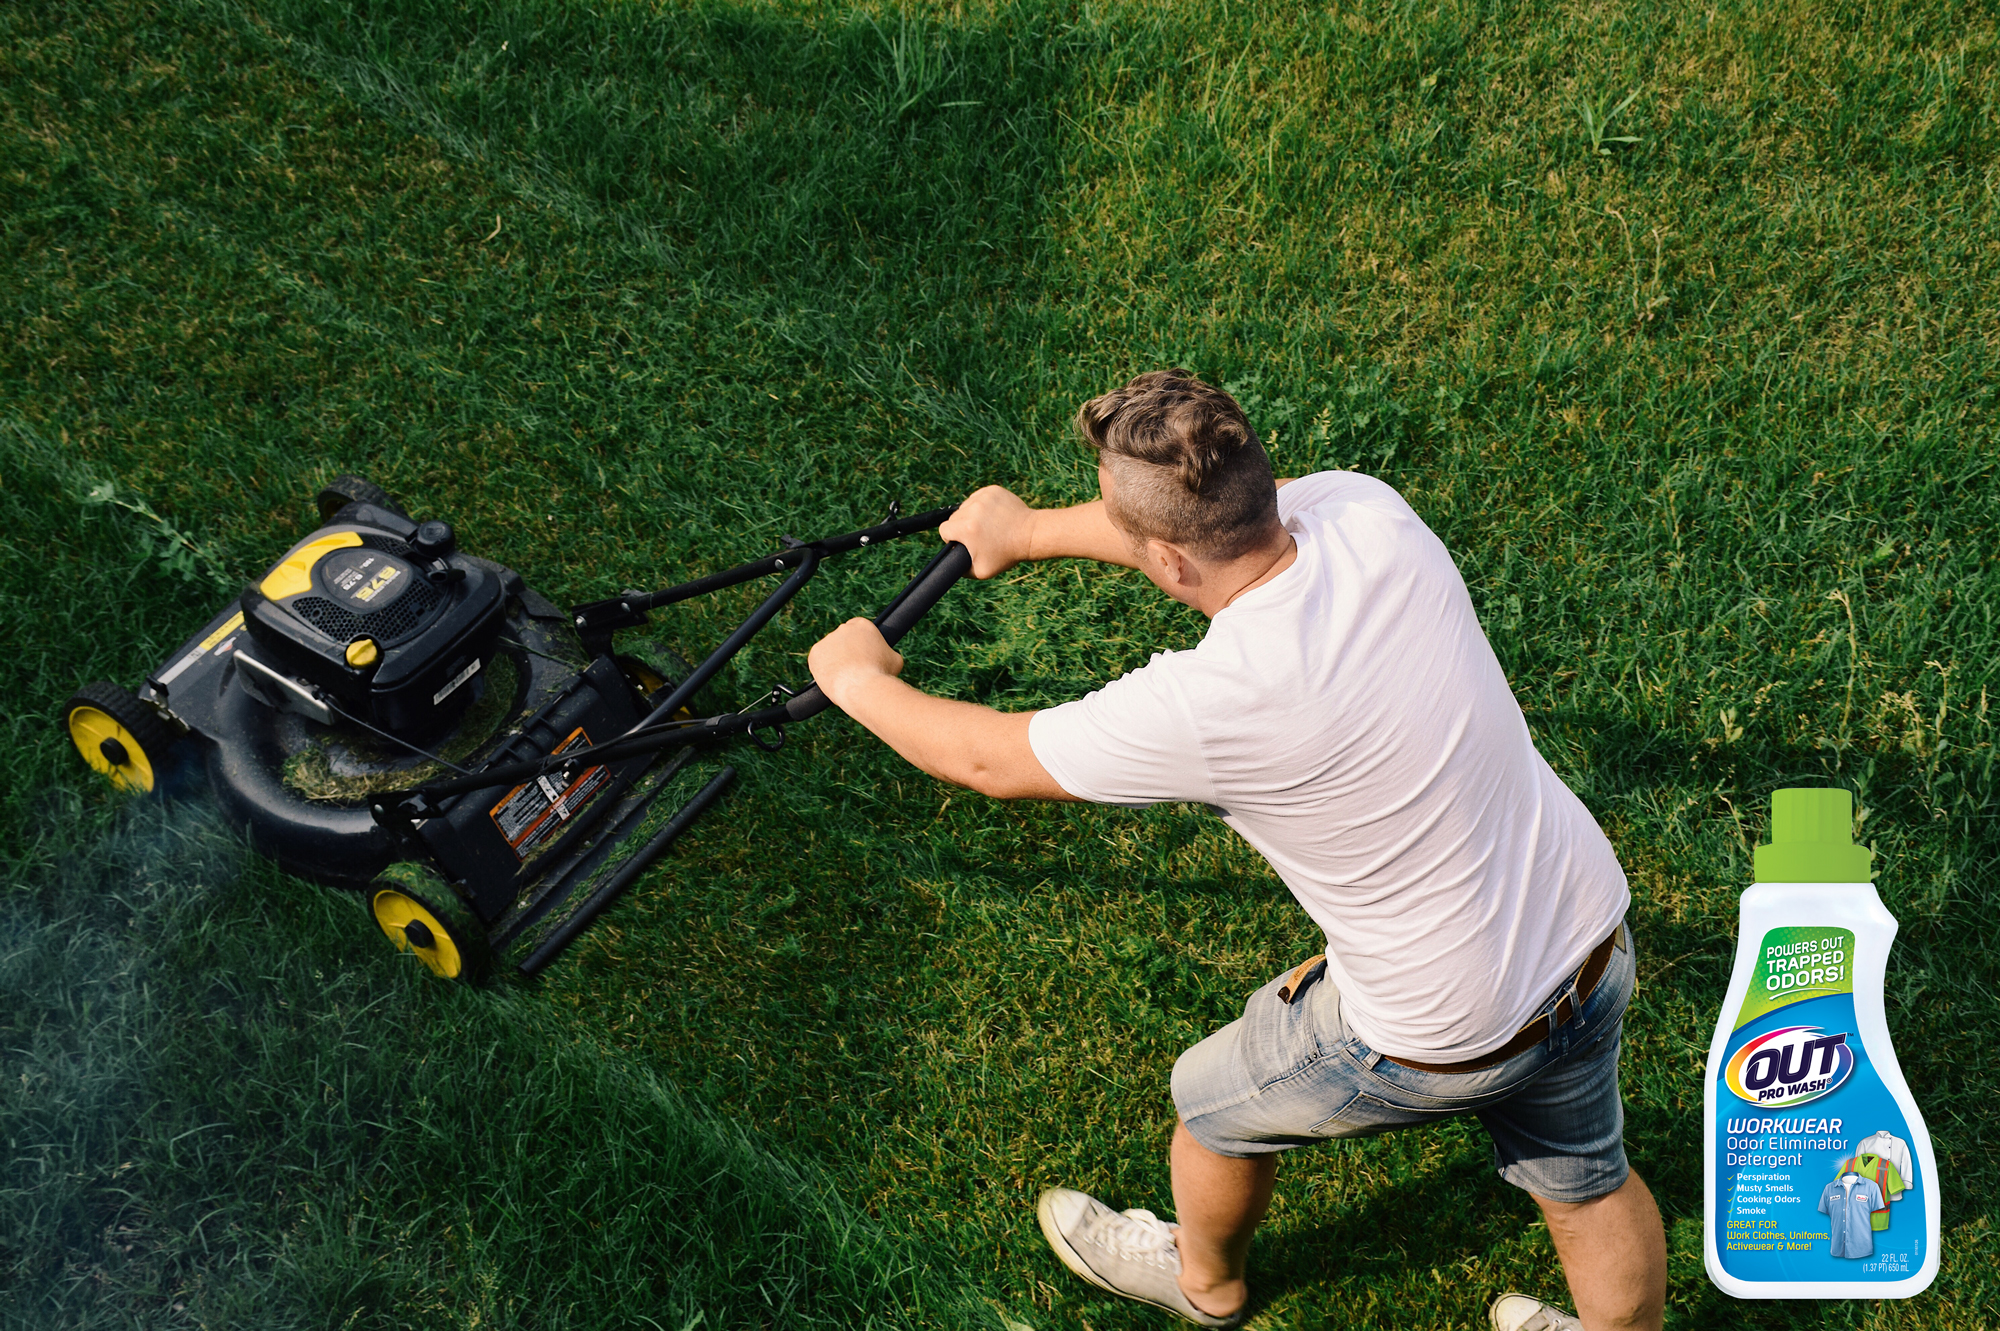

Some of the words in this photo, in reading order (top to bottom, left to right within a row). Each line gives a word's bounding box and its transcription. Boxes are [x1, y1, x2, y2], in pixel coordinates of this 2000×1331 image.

[1767, 940, 1818, 959] POWERS
[1821, 936, 1844, 950] OUT
[1766, 950, 1845, 974] TRAPPED
[1766, 965, 1845, 991] ODORS!
[1757, 1086, 1785, 1101] PRO
[1726, 1118, 1843, 1134] WORKWEAR
[1727, 1137, 1766, 1150] Odor
[1769, 1137, 1849, 1150] Eliminator
[1727, 1153, 1802, 1168] Detergent
[1736, 1173, 1790, 1183] Perspiration
[1736, 1184, 1762, 1193] Musty
[1765, 1184, 1793, 1192] Smells
[1736, 1195, 1772, 1205] Cooking
[1774, 1195, 1801, 1203] Odors
[1736, 1206, 1766, 1214] Smoke
[1727, 1220, 1757, 1229] GREAT
[1759, 1220, 1778, 1229] FOR
[1727, 1231, 1751, 1240] Work
[1752, 1231, 1787, 1241] Clothes,
[1789, 1231, 1830, 1241] Uniforms,
[1727, 1242, 1775, 1251] Activewear
[1777, 1242, 1784, 1251] &
[1786, 1242, 1812, 1251] More!
[1881, 1254, 1889, 1263] 22
[1878, 1262, 1888, 1272] PT)
[1888, 1262, 1899, 1272] 650
